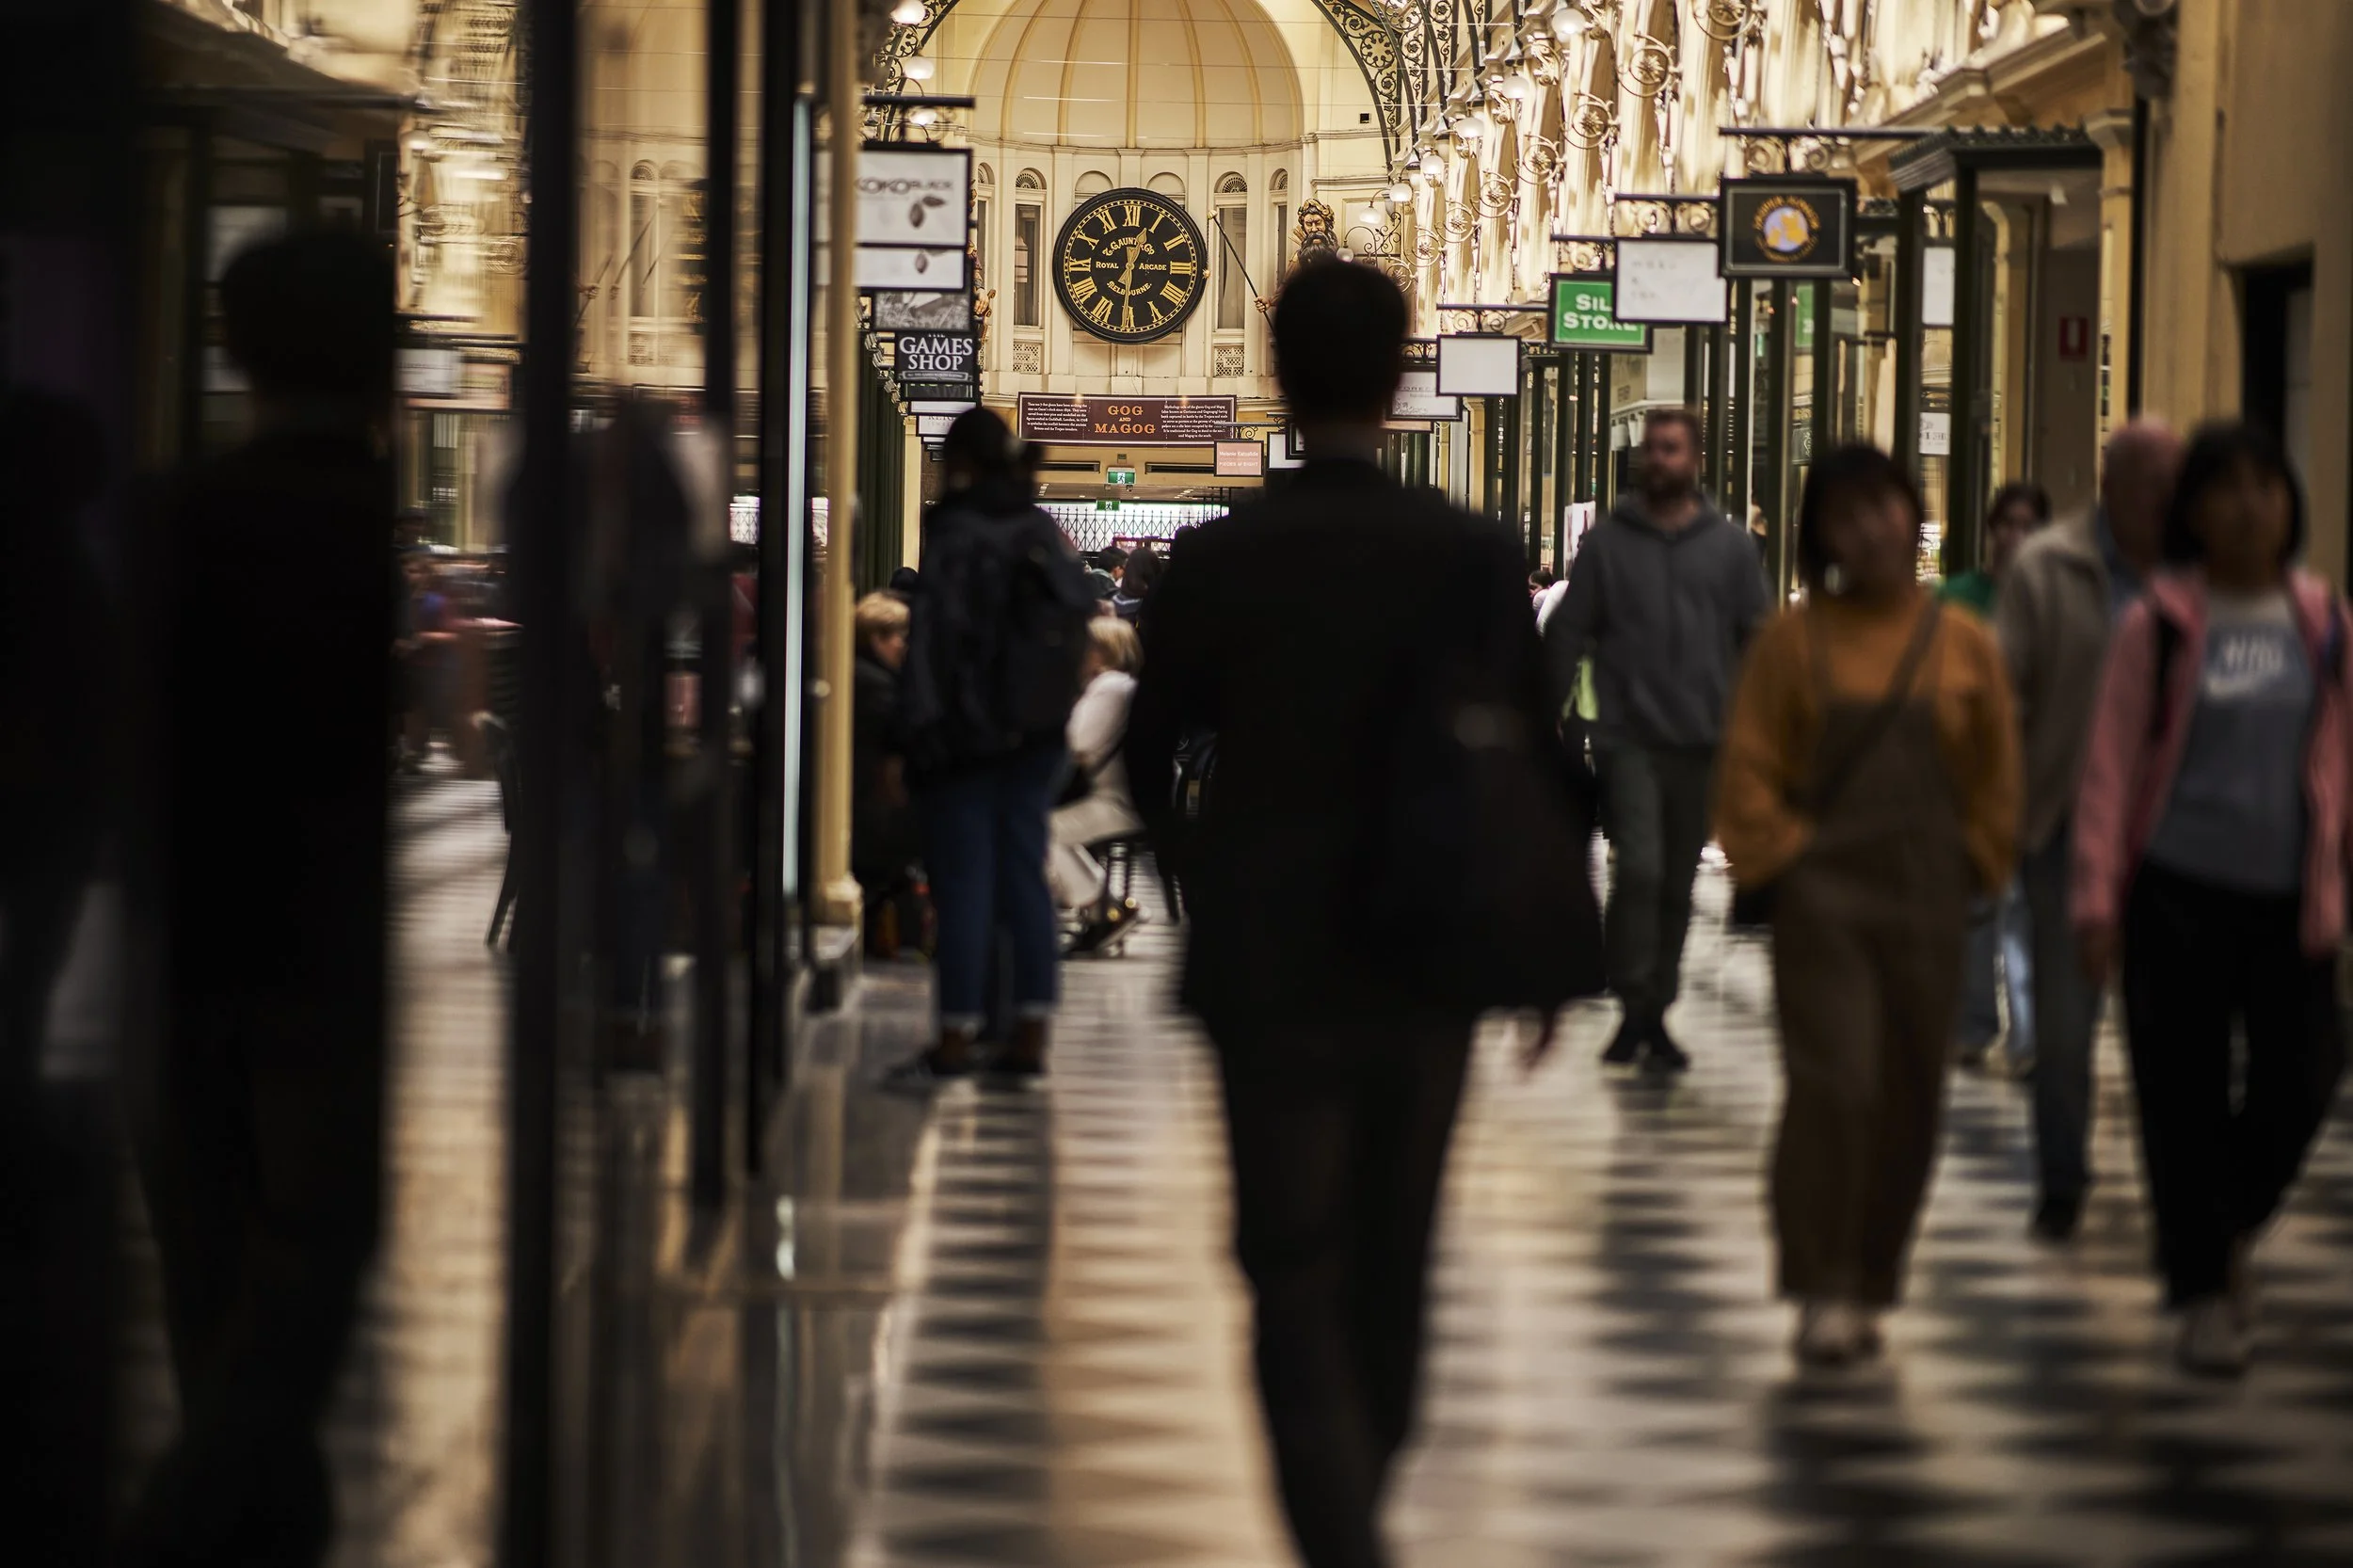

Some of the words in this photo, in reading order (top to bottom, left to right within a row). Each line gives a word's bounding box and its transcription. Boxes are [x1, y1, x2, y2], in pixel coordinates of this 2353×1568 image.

[1096, 210, 1117, 234] XI
[1122, 205, 1142, 227] XII
[1149, 213, 1165, 233] I
[1077, 232, 1099, 250] X
[1163, 233, 1186, 252] II
[1069, 257, 1091, 272] IX
[1170, 261, 1193, 275] III
[1148, 301, 1164, 323] V
[1576, 293, 1613, 312] SIL
[899, 336, 973, 355] GAMES
[908, 354, 963, 370] SHOP
[1108, 405, 1143, 415] GOG
[1094, 423, 1155, 434] MAGOG
